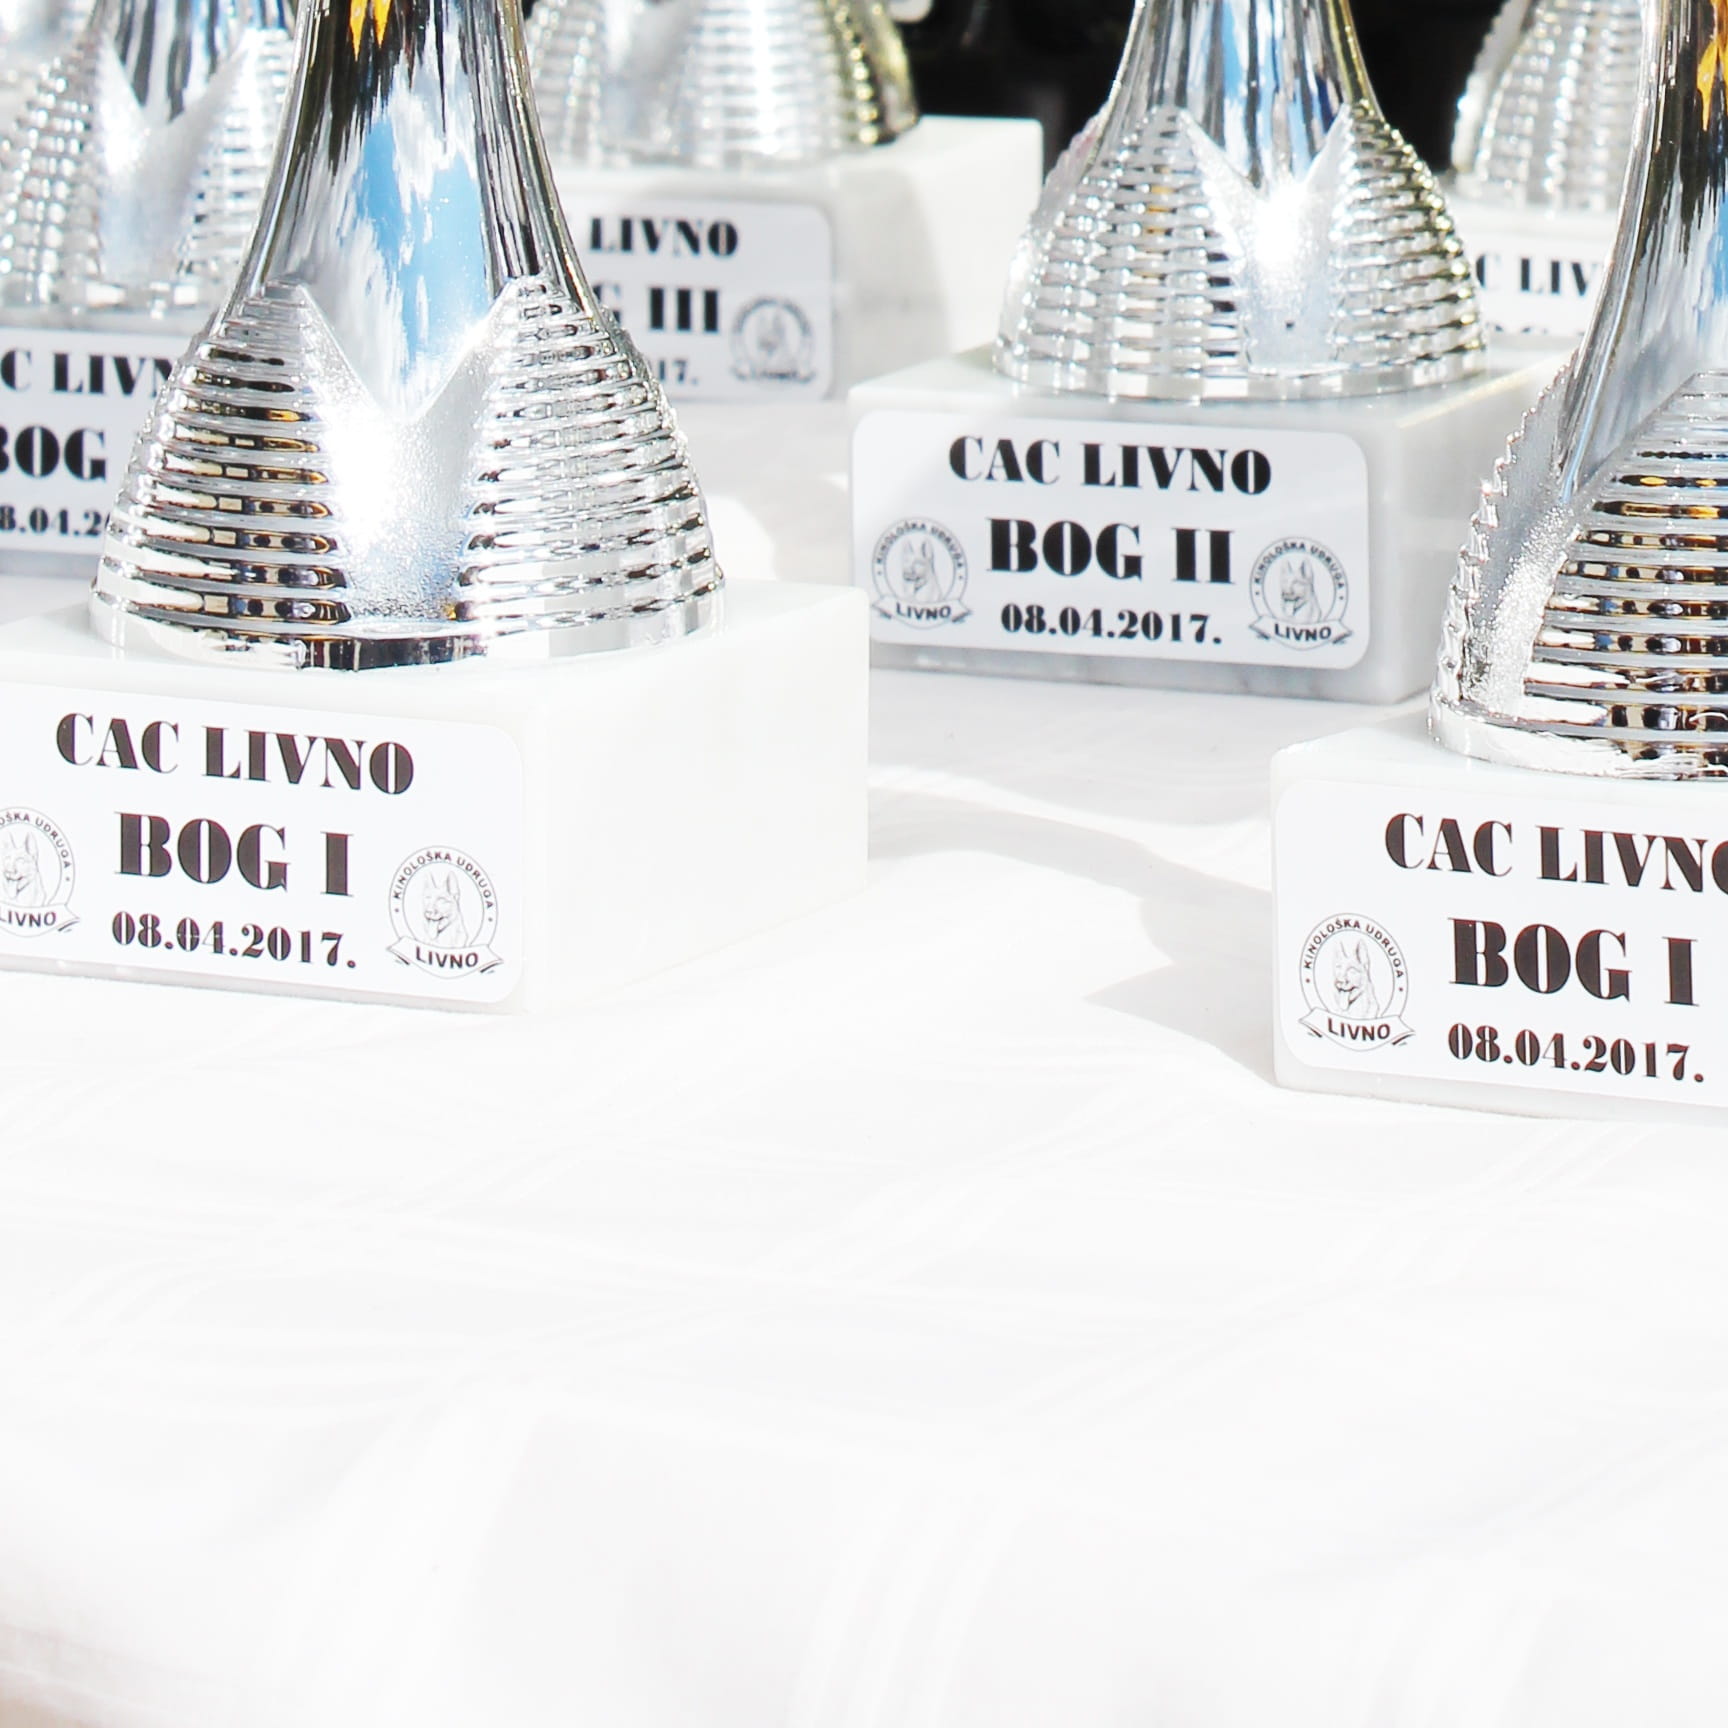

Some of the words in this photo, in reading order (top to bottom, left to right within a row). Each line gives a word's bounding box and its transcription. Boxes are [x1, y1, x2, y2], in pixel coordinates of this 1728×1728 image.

[590, 217, 738, 256] LIVNO
[1520, 257, 1603, 297] LIV
[648, 287, 719, 332] III
[0, 424, 107, 482] OG
[949, 435, 1060, 486] CAC
[1080, 442, 1272, 496] LIVNO
[986, 517, 1144, 582] BOG
[1171, 527, 1237, 585] II
[896, 602, 951, 620] LIVNO
[1000, 603, 1223, 645] 08.04.2017.
[1274, 623, 1332, 641] LIVNO
[56, 713, 179, 774] CAC
[202, 725, 414, 795] LIVNO
[114, 811, 289, 892] BOG
[321, 831, 354, 897] I
[1384, 813, 1512, 877] CAC
[112, 911, 357, 969] 08.04.2017.
[415, 946, 479, 969] LIVNO
[1447, 917, 1632, 1003] BOG
[1662, 935, 1700, 1008] I
[1328, 1017, 1391, 1041] LIVNO
[1447, 1023, 1705, 1084] 08.04.2017.
